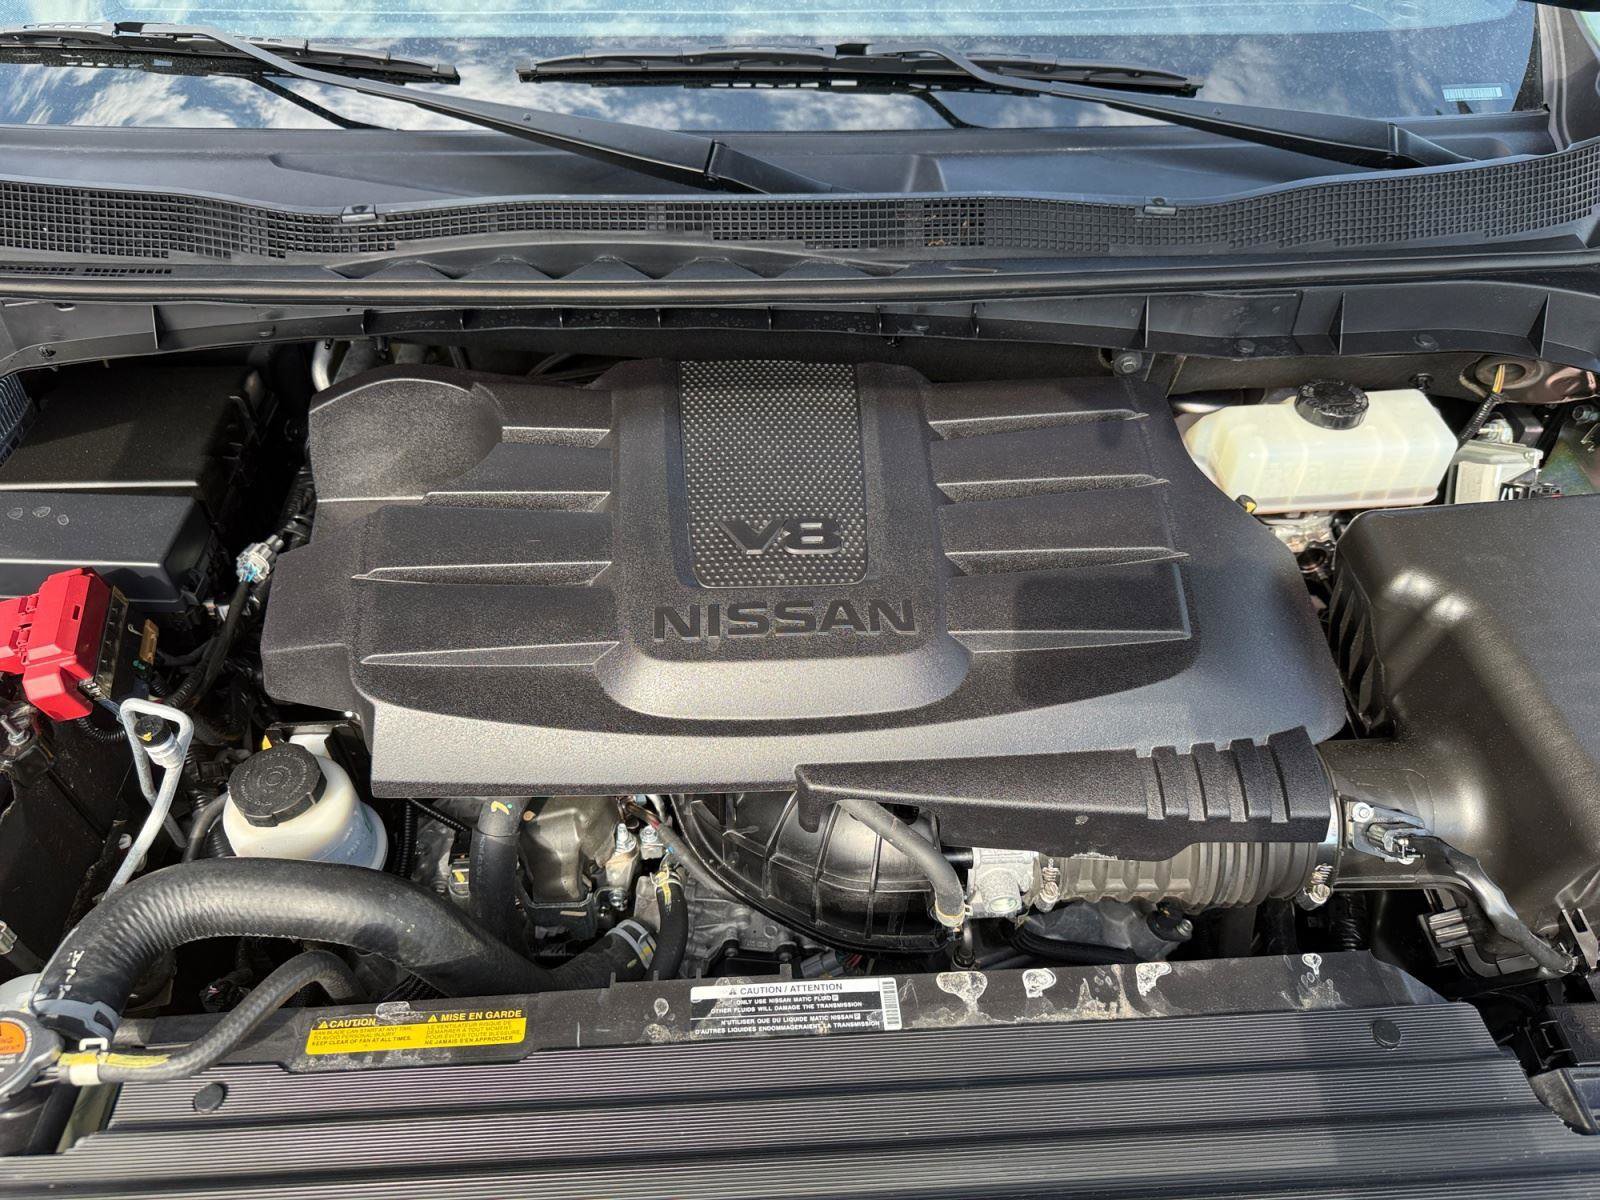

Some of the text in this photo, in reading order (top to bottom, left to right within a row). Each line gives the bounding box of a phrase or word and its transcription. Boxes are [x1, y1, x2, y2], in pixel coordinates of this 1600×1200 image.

[716, 518, 842, 555] V8
[653, 599, 917, 642] NISSAN
[740, 986, 782, 994] CAUTION
[790, 984, 842, 992] ATTENTION
[441, 1010, 522, 1022] MISE EN GARDE
[328, 1018, 376, 1028] CAUTION
[759, 1024, 820, 1032] ENDOMMAGERAIENT
